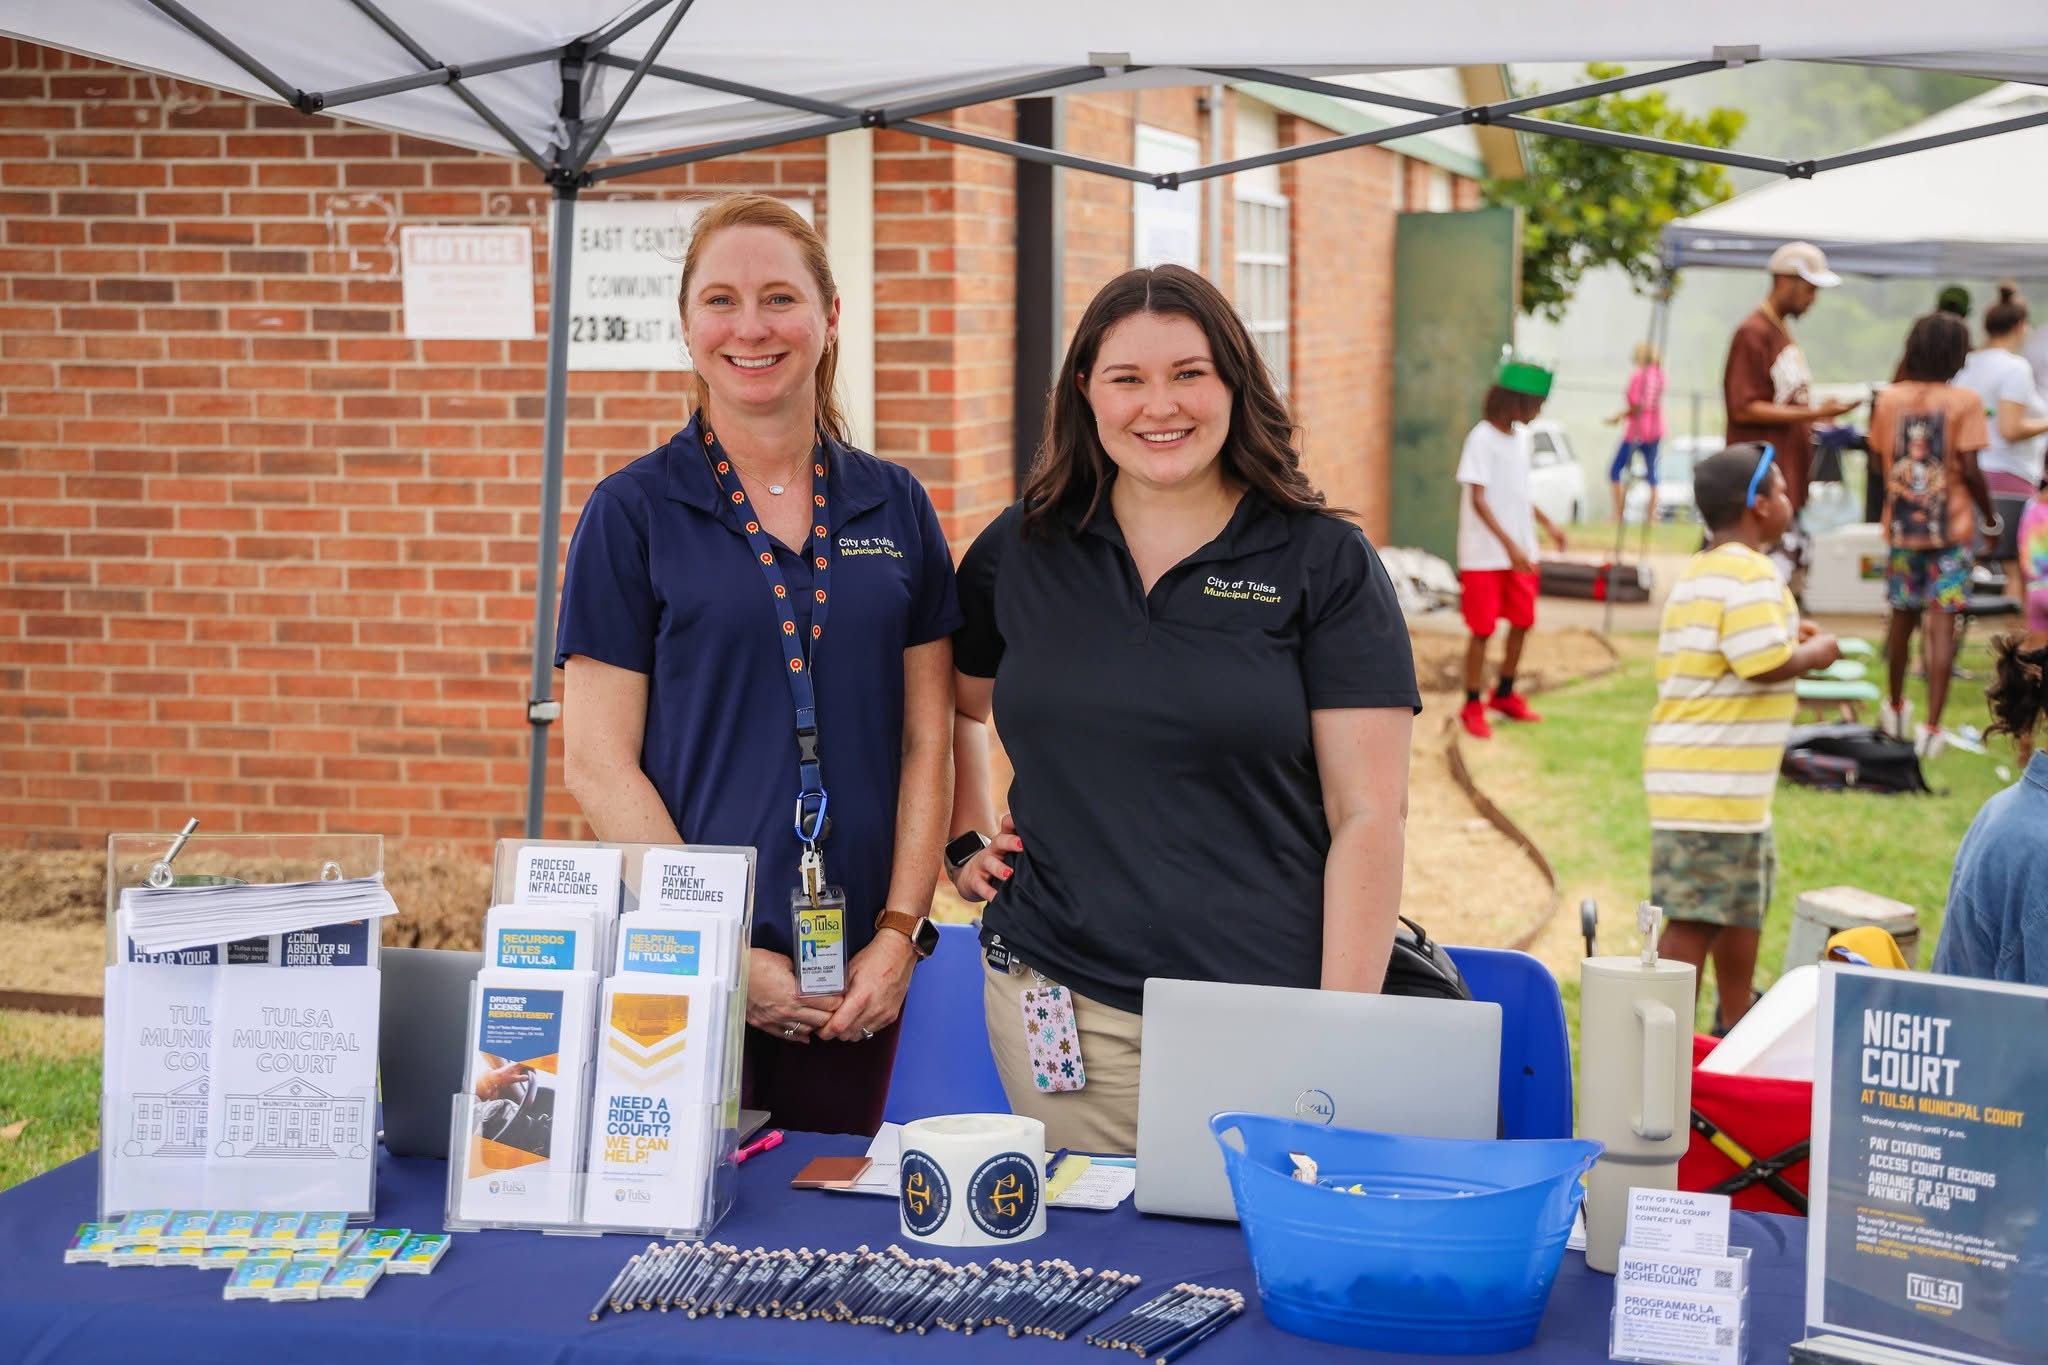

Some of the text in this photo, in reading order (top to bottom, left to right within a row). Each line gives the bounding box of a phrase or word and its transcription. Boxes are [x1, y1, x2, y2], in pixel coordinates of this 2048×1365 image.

[581, 228, 621, 252] EAST
[412, 236, 517, 261] NOTICE
[839, 537, 894, 548] City of Tulsa
[841, 547, 882, 556] Municipal
[1207, 576, 1276, 594] City of Tulsa
[1203, 586, 1281, 603] Municipal Court
[531, 859, 575, 871] PROCESO
[663, 865, 696, 877] TICKET
[530, 870, 591, 883] PARA PAGAR
[662, 877, 705, 890] PAYMENT
[528, 882, 598, 895] INFRACCIONES
[661, 889, 723, 902] PROCEDURES
[813, 917, 839, 931] Tulsa
[503, 934, 565, 945] RECURSOS
[630, 934, 677, 945] HELPFUL
[287, 944, 350, 954] ABSOLVER SU
[629, 943, 695, 954] RESOURCES
[179, 950, 211, 965] YOUR
[287, 955, 332, 965] ORDEN DE
[502, 955, 556, 965] EN TULSA
[629, 952, 677, 963] IN TULSA
[489, 996, 527, 1004] DRIVER'S
[262, 1006, 334, 1028] TULSA
[1863, 1008, 1952, 1056] NIGHT
[232, 1028, 360, 1052] MUNICIPAL
[256, 1052, 337, 1074] COURT
[1861, 1048, 1960, 1096] COURT
[609, 1095, 668, 1110] NEED A
[1301, 1104, 1330, 1115] DELL
[1861, 1089, 2024, 1128] AT TULSA MUNICIPAL COURT
[608, 1109, 670, 1124] RIDE TO
[607, 1122, 671, 1138] COURT?
[1862, 1115, 1967, 1139] Thursday nights until 7 p.m.
[606, 1135, 669, 1151] WE CAN
[1869, 1136, 1942, 1161] PAY CITATIONS
[604, 1149, 649, 1164] HELP!
[1868, 1154, 1996, 1188] ACCESS COURT RECORDS
[501, 1181, 526, 1193] Tulsa
[1868, 1171, 1977, 1202] ARRANGE OR EXTEND
[627, 1189, 651, 1201] Tulsa
[1636, 1194, 1654, 1202] CITY
[1670, 1197, 1695, 1206] TULSA
[1867, 1183, 1950, 1210] PAYMENT PLANS
[1635, 1205, 1711, 1217] MUNICIPAL COURT
[1635, 1214, 1673, 1223] CONTACT
[1856, 1225, 1878, 1236] Night
[1879, 1228, 1901, 1238] Court
[1901, 1233, 1916, 1242] and
[1918, 1237, 1953, 1249] schedule
[1857, 1215, 1866, 1223] To
[1867, 1218, 1889, 1229] verify
[1896, 1223, 1914, 1232] your
[1915, 1226, 1944, 1237] citation
[1953, 1233, 1983, 1245] eligible
[1983, 1238, 1996, 1247] for
[1856, 1235, 1877, 1244] email
[1981, 1258, 1991, 1266] or
[1991, 1260, 2007, 1269] call
[1624, 1261, 1703, 1277] NIGHT COURT
[1624, 1270, 1698, 1287] SCHEDULING
[1911, 1279, 1957, 1304] TULSA
[1624, 1296, 1714, 1313] PROGRAMAR LA
[1624, 1305, 1722, 1325] CORTE DE NOCHE
